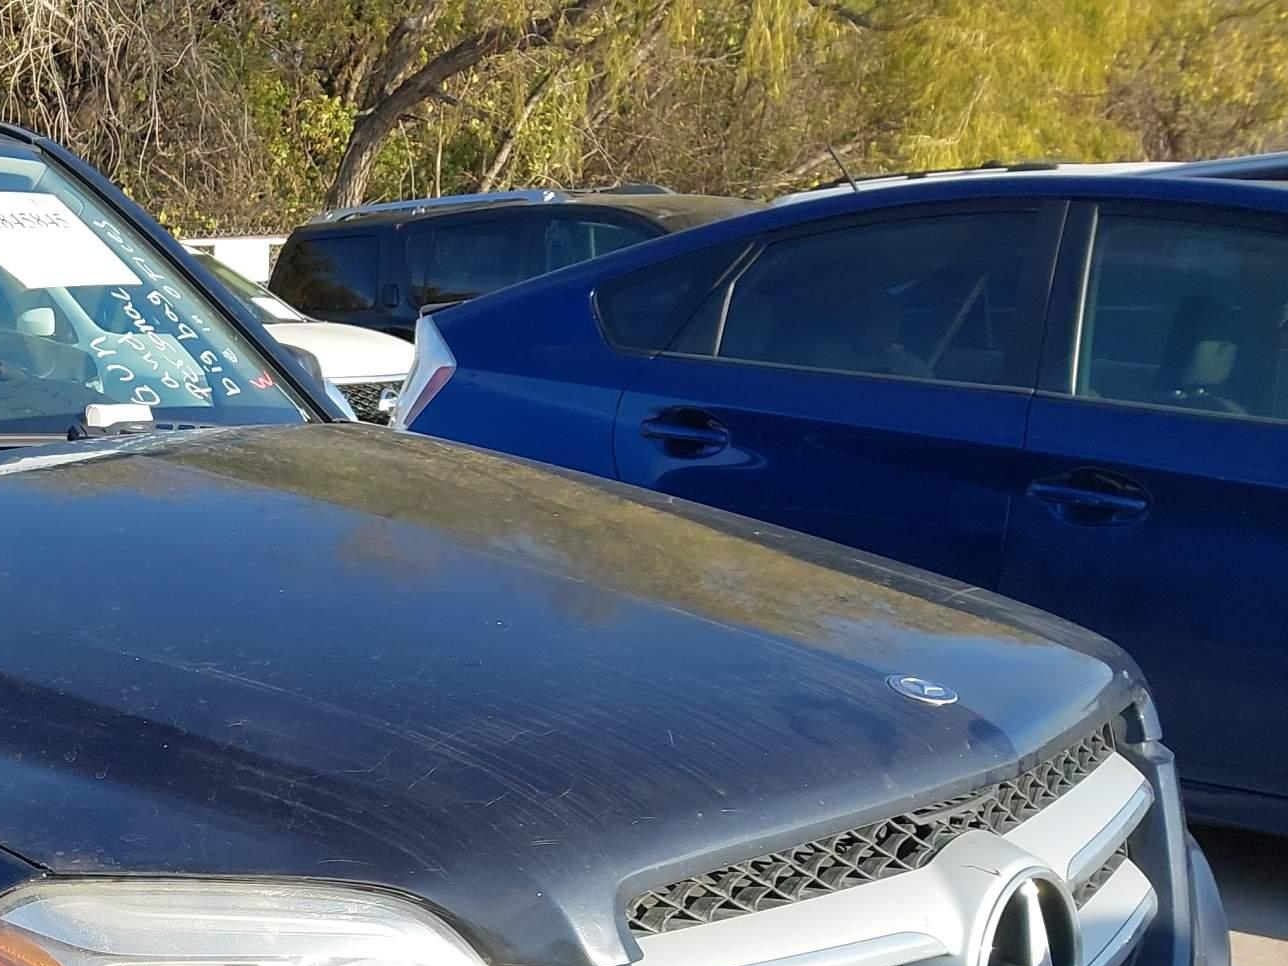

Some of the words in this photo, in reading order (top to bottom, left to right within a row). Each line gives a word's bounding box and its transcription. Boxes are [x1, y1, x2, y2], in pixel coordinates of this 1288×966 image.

[147, 291, 199, 340] bag
[118, 331, 180, 389] and
[200, 351, 242, 396] big
